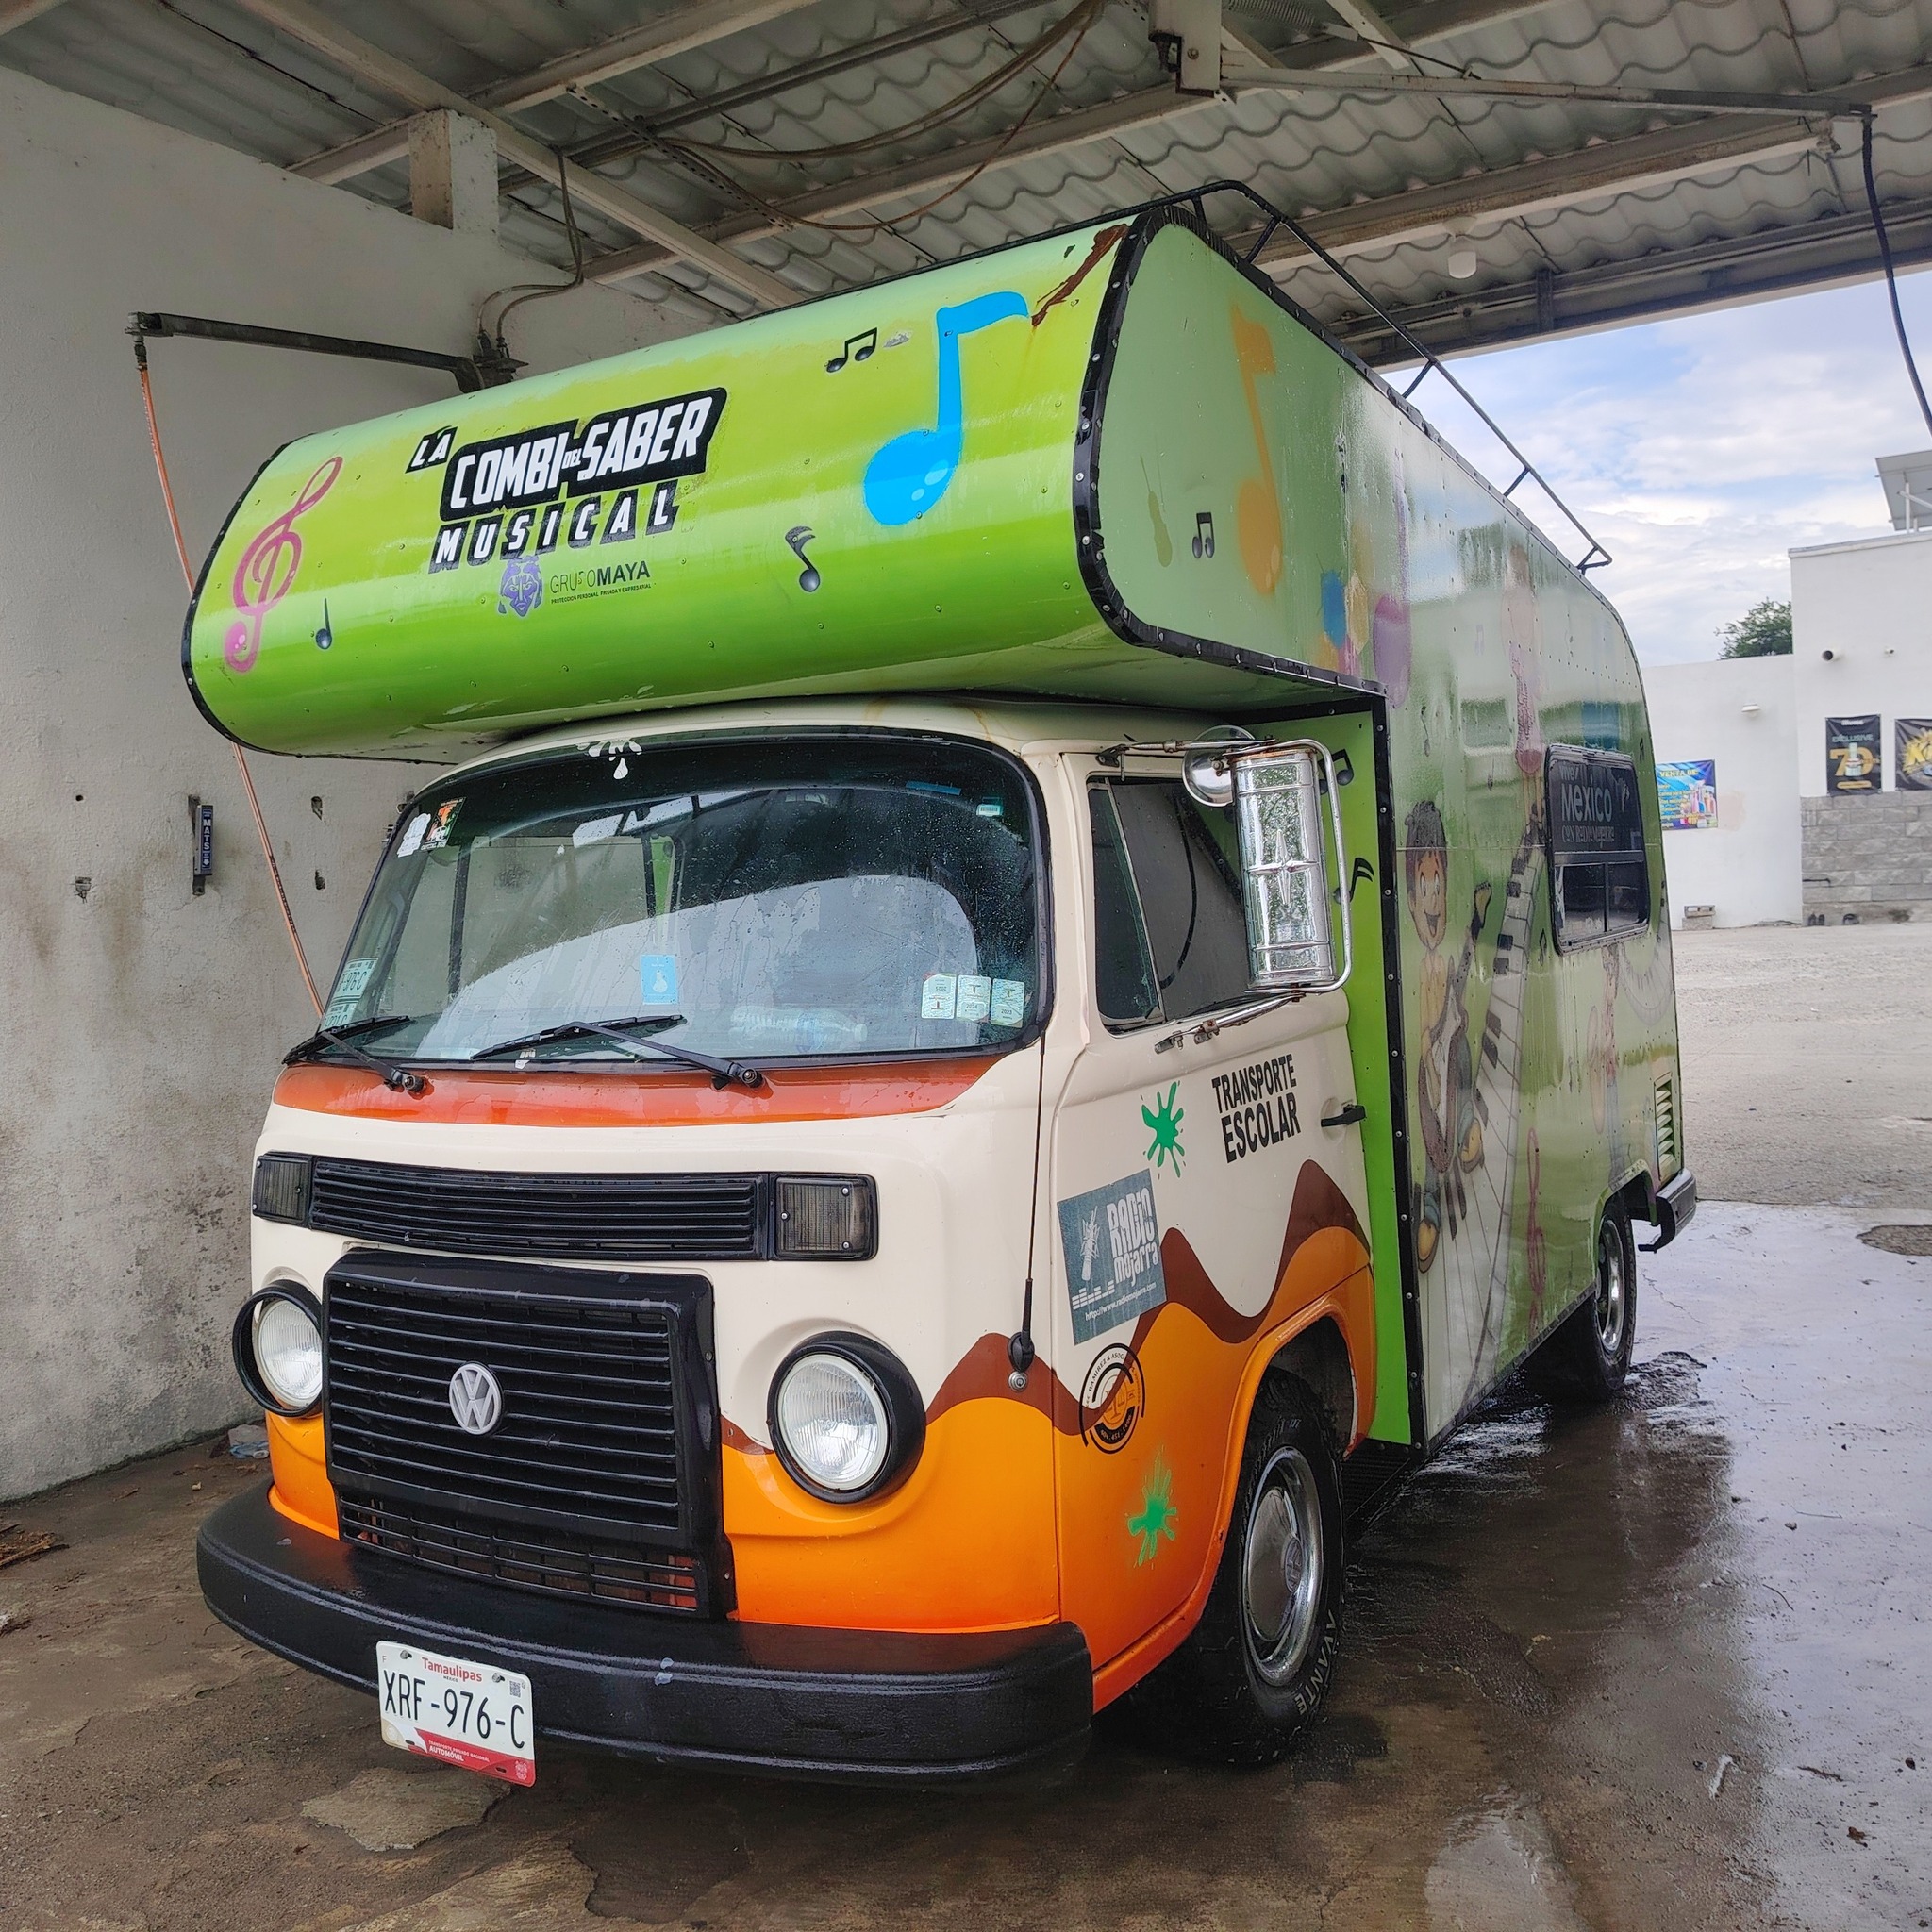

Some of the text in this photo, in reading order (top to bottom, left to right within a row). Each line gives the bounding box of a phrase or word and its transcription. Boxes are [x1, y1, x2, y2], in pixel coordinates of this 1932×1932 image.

[411, 432, 453, 469] LA
[449, 395, 713, 510] COMBI DEL SABER
[433, 487, 673, 566] MUSICAL
[202, 818, 212, 850] MATS
[1211, 1053, 1297, 1114] TRANSPORTE
[1221, 1091, 1302, 1164] ESCOLAR
[1113, 1241, 1159, 1287] mojarra
[421, 1657, 483, 1683] Tamaulipas
[382, 1669, 525, 1749] XRF-976-C
